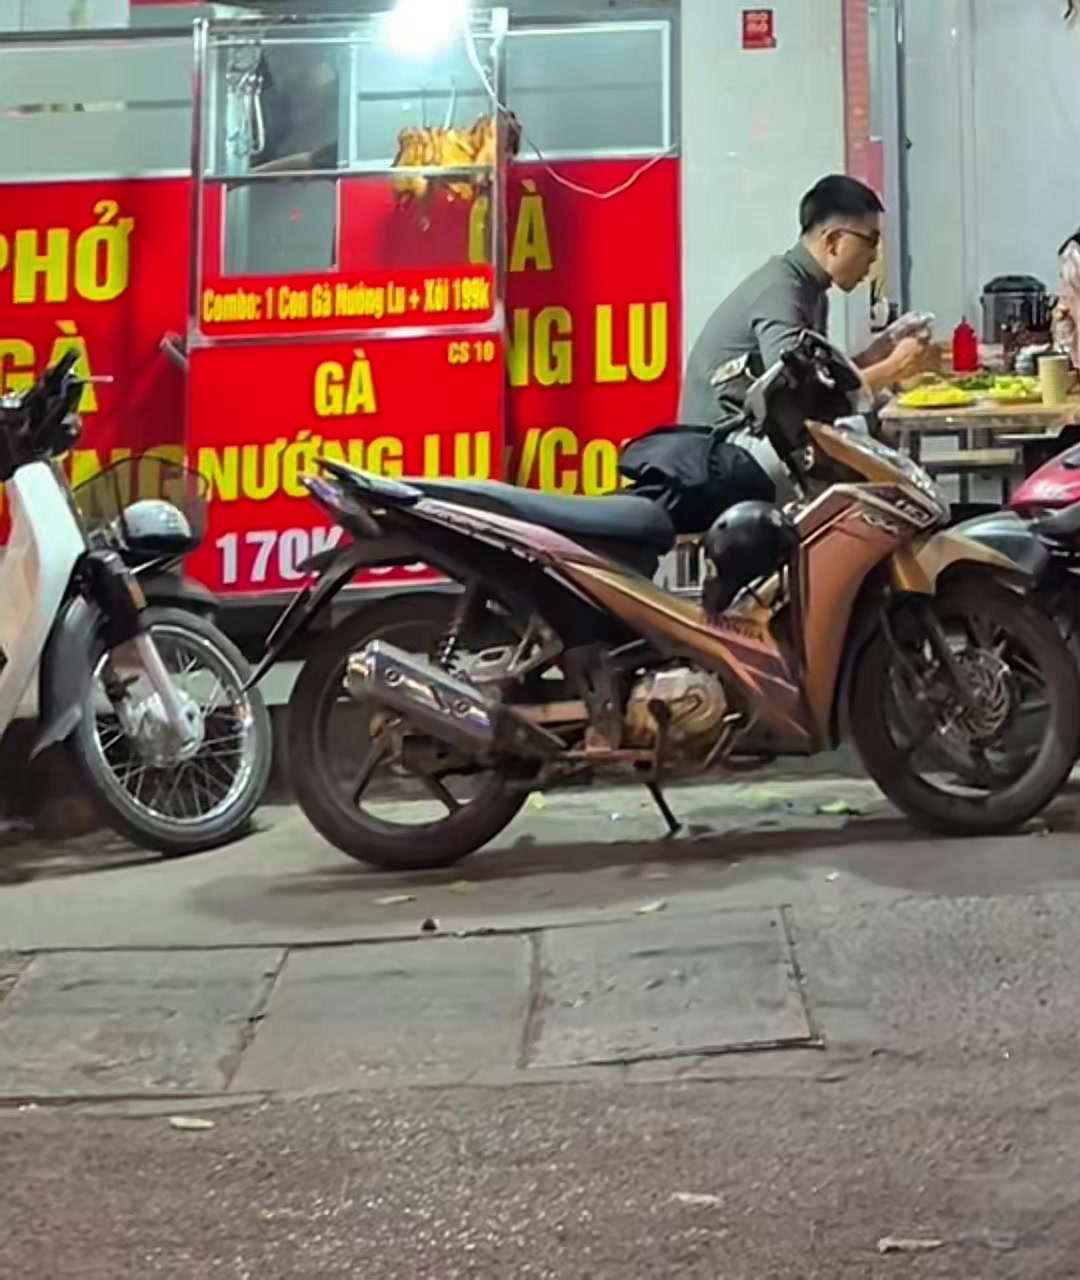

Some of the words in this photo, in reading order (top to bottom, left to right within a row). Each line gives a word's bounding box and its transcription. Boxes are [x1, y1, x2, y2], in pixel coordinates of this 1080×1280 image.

[203, 289, 262, 322] Combo:
[265, 287, 274, 319] 1
[278, 284, 308, 319] Con
[446, 342, 471, 364] CS
[474, 340, 496, 362] 10
[596, 303, 666, 382] LU
[314, 348, 377, 416] GÀ
